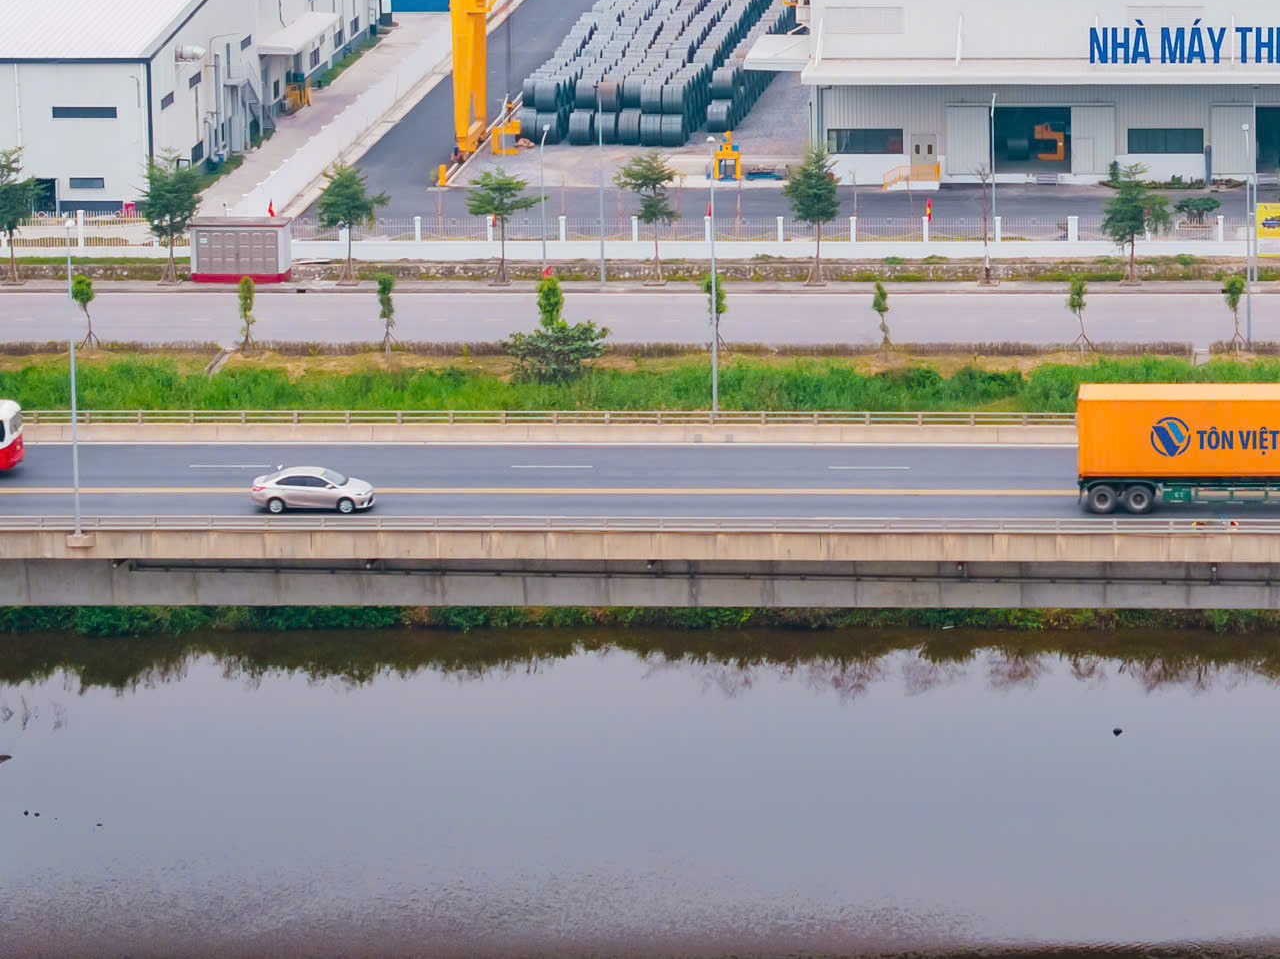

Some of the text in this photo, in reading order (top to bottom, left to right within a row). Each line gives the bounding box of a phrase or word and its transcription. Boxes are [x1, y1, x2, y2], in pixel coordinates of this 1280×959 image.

[1089, 18, 1151, 64] NHÀ
[1160, 18, 1227, 64] MÁY
[1196, 426, 1234, 450] TÔN
[1239, 426, 1280, 455] VIỆT
